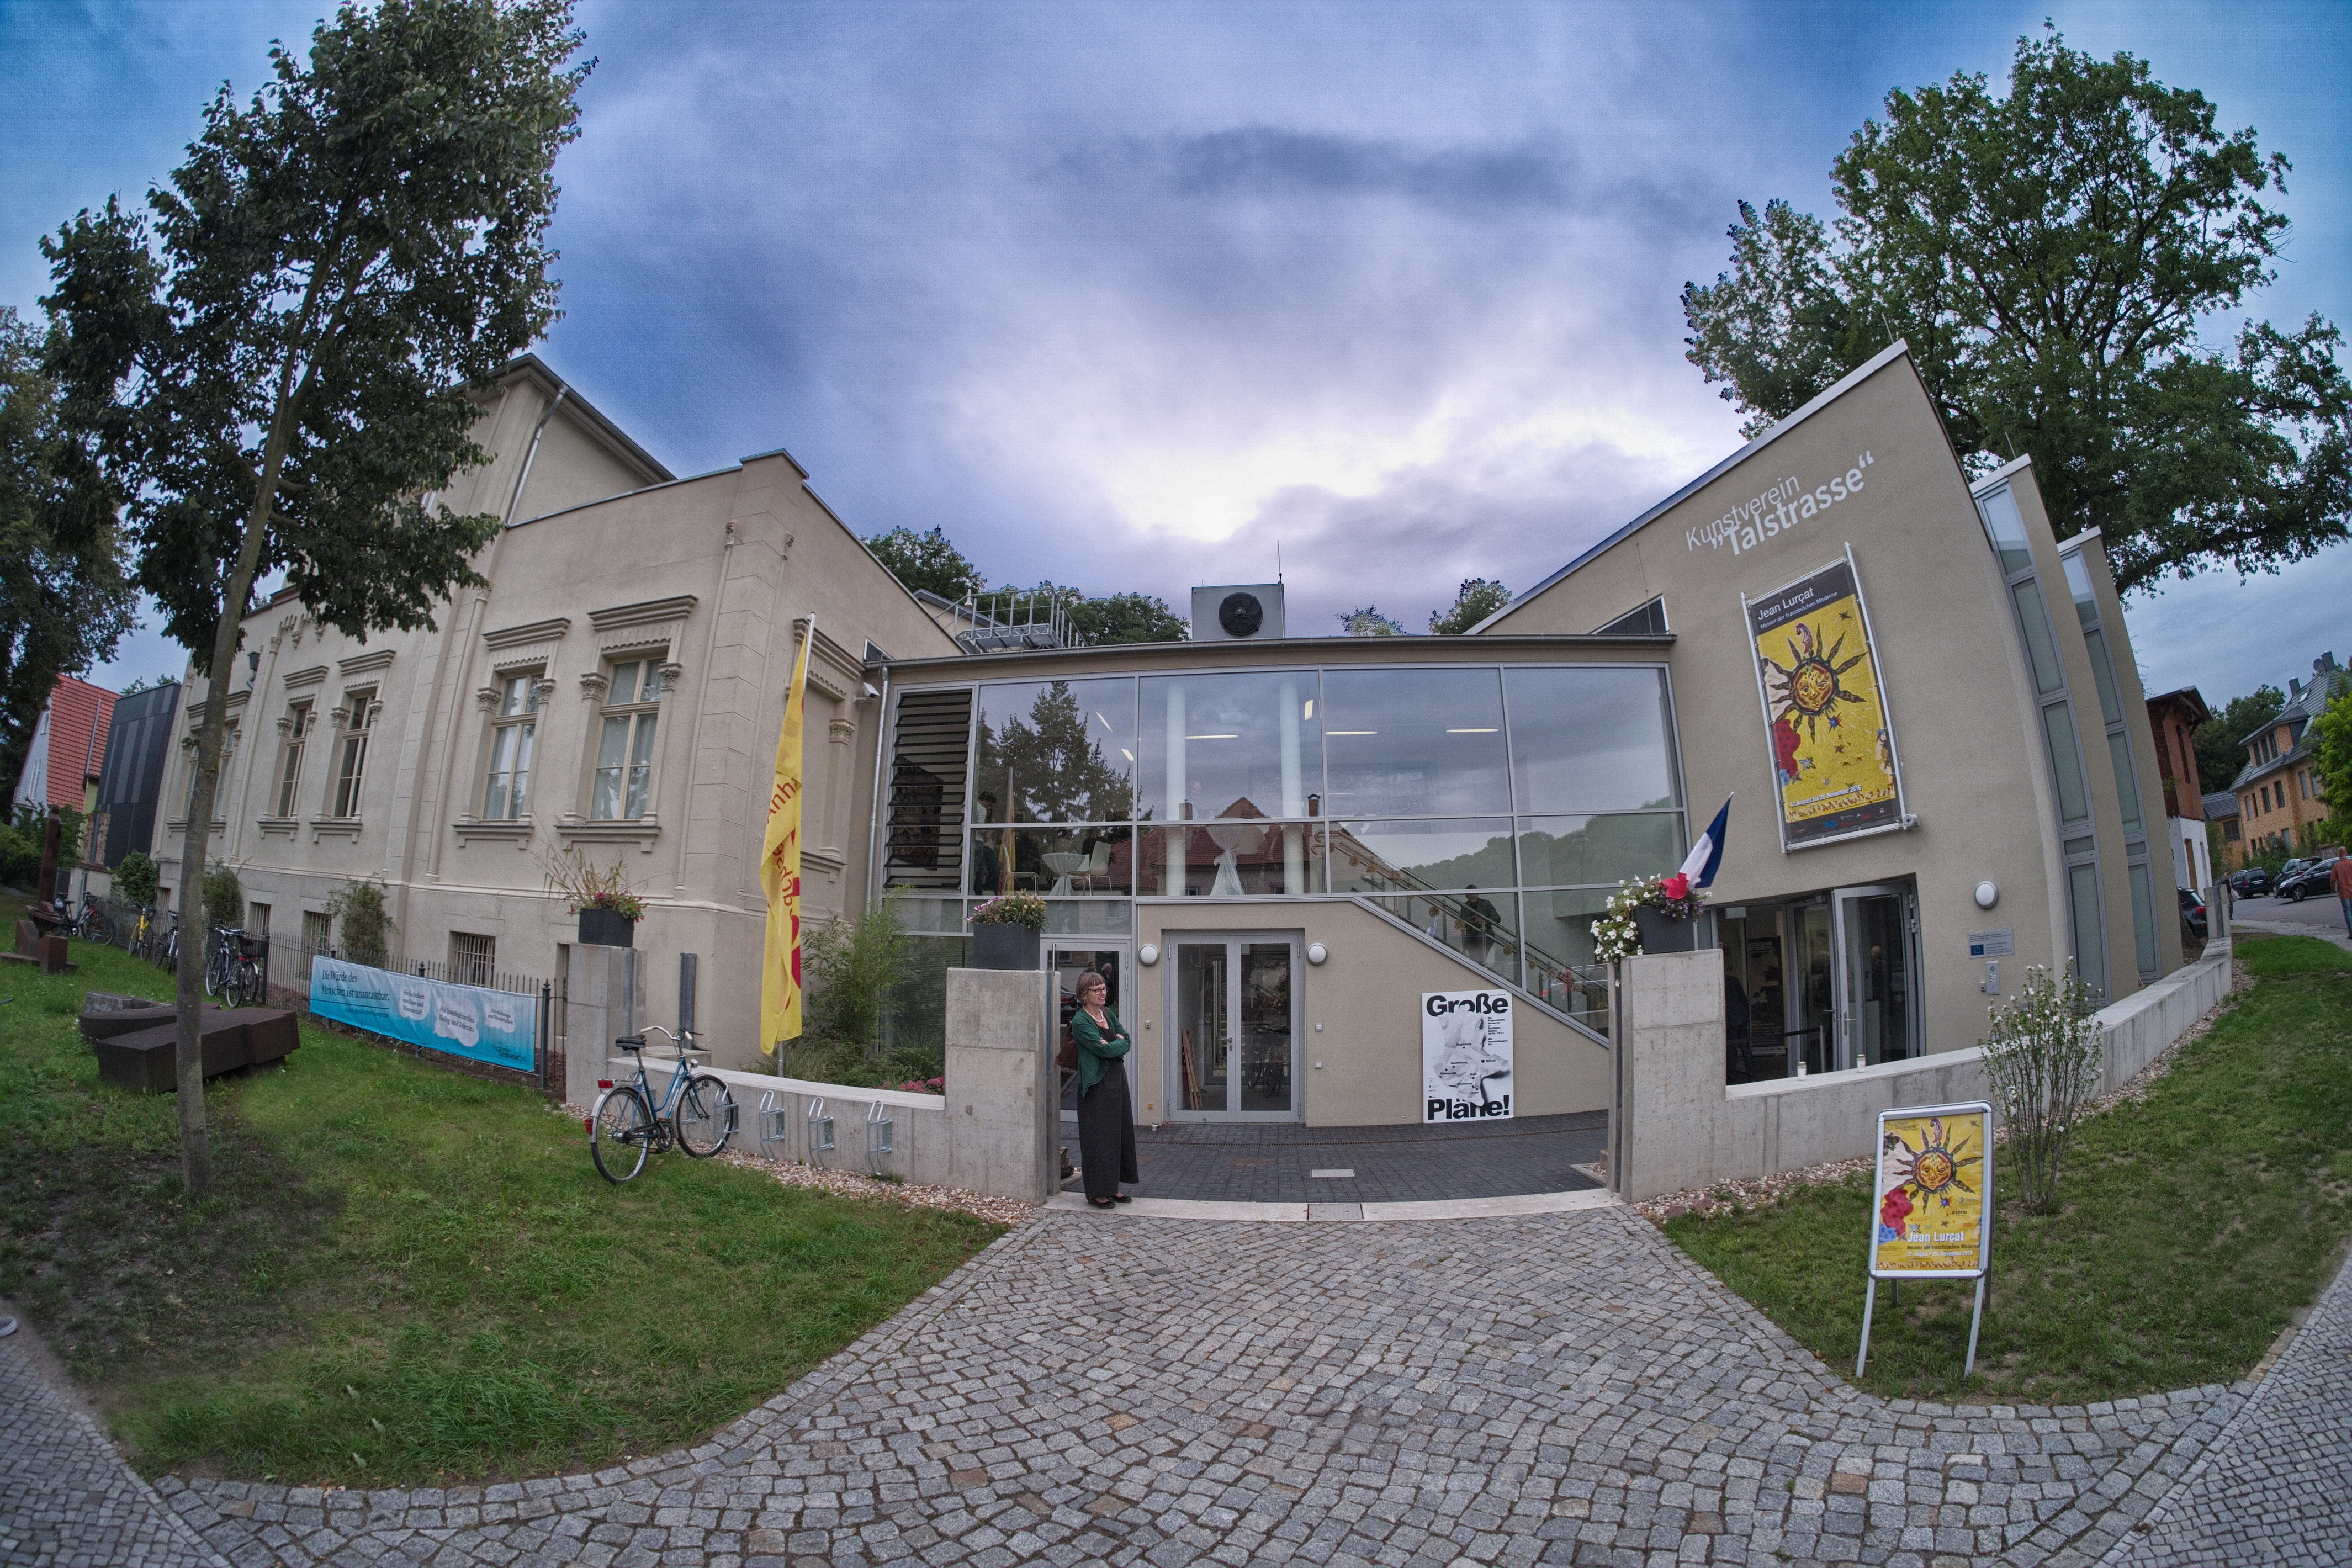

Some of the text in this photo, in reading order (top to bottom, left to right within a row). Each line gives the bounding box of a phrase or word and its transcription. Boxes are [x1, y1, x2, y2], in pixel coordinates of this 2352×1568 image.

[1686, 476, 1800, 551] Kunstverein
[1758, 587, 1815, 621] Jean Lurçat
[1760, 619, 1777, 629] Meister
[1785, 601, 1816, 618] französischen
[1816, 591, 1838, 605] Moderne
[1827, 788, 1850, 799] November
[1850, 785, 1862, 793] 2016
[322, 970, 358, 982] Die Würde des
[322, 984, 345, 996] Menschen
[355, 989, 390, 1001] unantastbar.
[1426, 993, 1509, 1017] Große
[1428, 1095, 1509, 1120] Pläne!
[1906, 1230, 1964, 1244] Jean Lurçat
